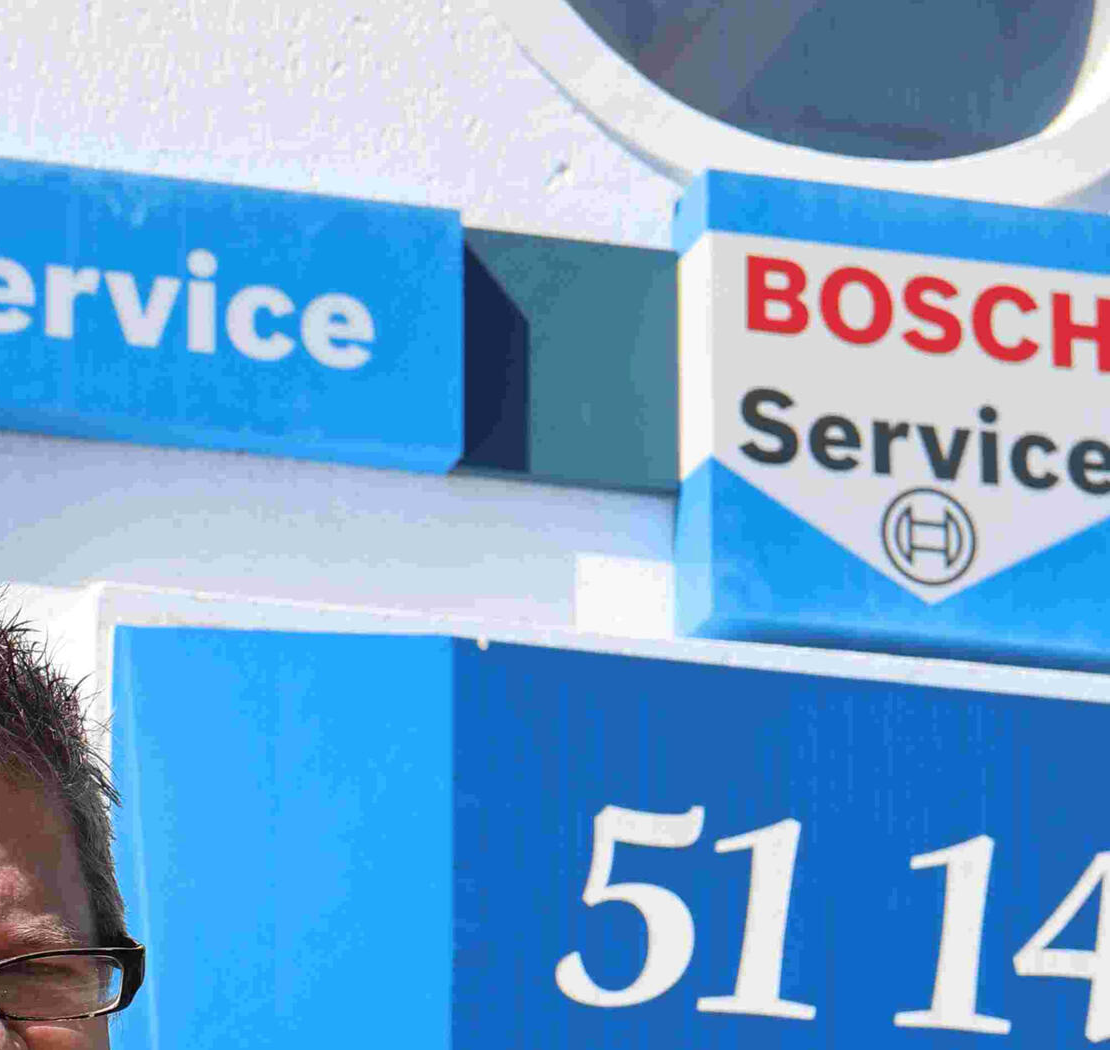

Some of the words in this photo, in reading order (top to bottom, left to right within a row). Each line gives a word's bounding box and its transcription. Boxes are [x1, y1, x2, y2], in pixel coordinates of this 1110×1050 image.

[745, 253, 1110, 374] BOSCH
[738, 387, 1110, 496] Service
[554, 804, 817, 1021] 51
[893, 833, 1110, 1044] 14
